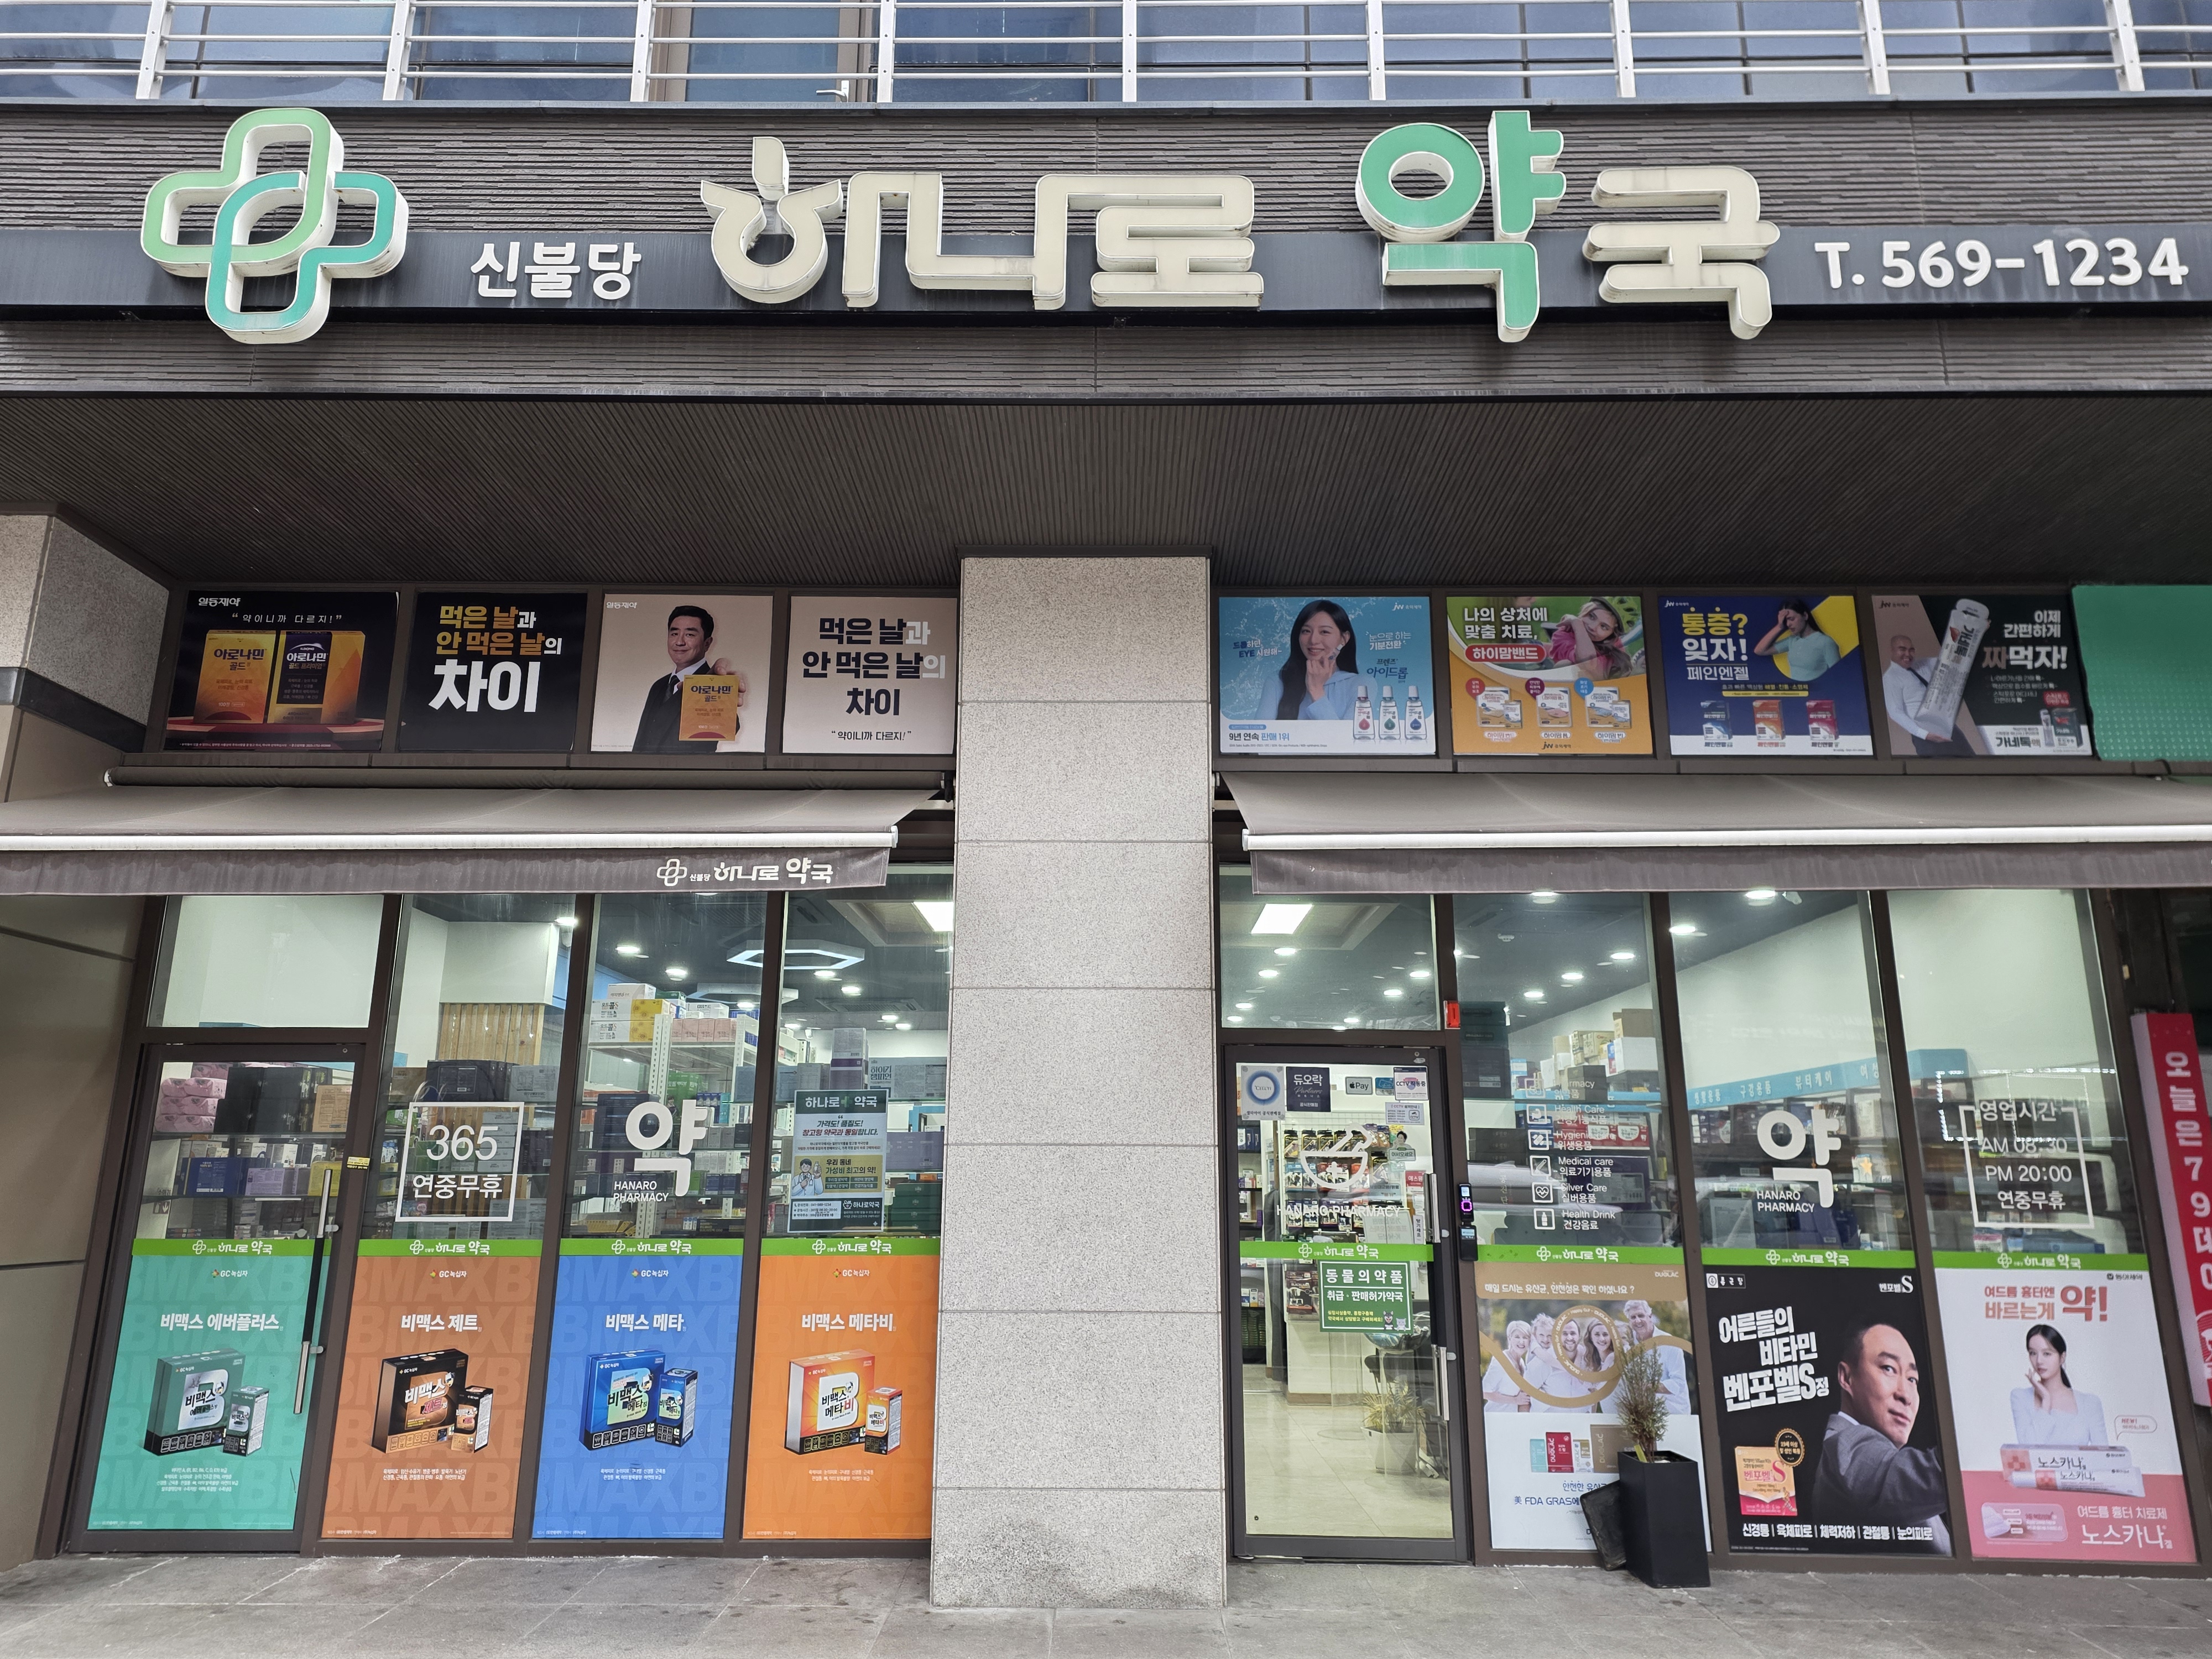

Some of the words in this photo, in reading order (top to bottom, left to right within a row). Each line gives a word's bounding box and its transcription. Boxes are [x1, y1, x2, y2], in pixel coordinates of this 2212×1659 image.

[471, 242, 641, 299] 신불당
[701, 137, 1264, 310] 하나로
[1355, 111, 1780, 342] 약국
[1814, 241, 1865, 289] T.
[1882, 237, 2189, 289] 569-1234
[199, 597, 241, 606] 일동제약
[606, 601, 637, 609] 일동제약
[440, 606, 487, 629] 먹은
[494, 607, 536, 629] 날과
[1464, 607, 1495, 622] 나의
[1500, 607, 1547, 622] 상처에
[1682, 607, 1748, 635] 통증?
[2034, 611, 2060, 623] 이제
[819, 618, 871, 645] 먹은
[879, 618, 931, 645] 날과
[1369, 633, 1393, 642] 눈으로
[1395, 632, 1411, 640] 하는
[1465, 625, 1495, 639] 맞춤
[1502, 624, 1538, 640] 치료,
[2004, 624, 2061, 638] 간편하게
[436, 633, 461, 655] 안
[466, 632, 514, 656] 먹은
[520, 632, 562, 656] 날의
[1370, 641, 1402, 651] 기분전환
[1682, 638, 1748, 661] 잊자!
[214, 649, 264, 660] 아로나민
[286, 653, 326, 662] 아로나민
[1472, 646, 1538, 659] 하이맘밴드
[1982, 646, 2067, 669] 짜먹자!
[229, 662, 246, 670] 골드
[802, 653, 831, 678] 안
[836, 651, 889, 679] 먹은
[895, 652, 946, 680] 날의
[1366, 666, 1408, 679] 아이드롭
[1687, 666, 1749, 680] 페인엔젤
[429, 659, 540, 712] 차이
[691, 685, 731, 694] 아로나민
[846, 688, 899, 716] 차이
[1229, 733, 1241, 741] 9년
[1244, 733, 1259, 741] 연속
[1261, 733, 1276, 741] 판매
[1279, 733, 1290, 741] 1위
[714, 862, 779, 881] 하나로
[786, 858, 833, 884] 약국
[1293, 1074, 1322, 1086] 듀오락
[1356, 1082, 1369, 1091] Pay
[806, 1097, 839, 1108] 하나로
[854, 1096, 877, 1107] 약국
[1980, 1100, 2057, 1121] 영업시간
[426, 1125, 498, 1161] 365
[625, 1099, 707, 1197] 약
[1981, 1138, 2008, 1153] AM
[1558, 1157, 1592, 1166] Medical
[1757, 1109, 1841, 1208] 약
[1559, 1167, 1612, 1177] 의료기기용품
[1986, 1166, 2013, 1181] PM
[2018, 1165, 2072, 1182] 20:00
[413, 1175, 502, 1199] 연중무휴
[614, 1181, 657, 1190] HANARO
[1561, 1183, 1584, 1192] Silver
[1587, 1184, 1608, 1192] Care
[613, 1192, 669, 1202] PHARMACY
[1562, 1194, 1597, 1203] 실버용품
[1757, 1191, 1801, 1200] HANARO
[1997, 1190, 2066, 1210] 연중무휴
[1335, 1206, 1400, 1217] PHARMACY
[1562, 1211, 1590, 1219] Health
[1593, 1211, 1616, 1219] Drink
[1757, 1203, 1814, 1212] PHARMACY
[1563, 1220, 1599, 1230] 건강음료
[1324, 1246, 1354, 1256] 하나로
[1357, 1245, 1379, 1259] 약국
[1563, 1249, 1593, 1259] 하나로
[1595, 1248, 1619, 1262] 약국
[1792, 1253, 1824, 1263] 하나로
[1825, 1251, 1849, 1266] 약국
[2023, 1256, 2055, 1266] 하나로
[2057, 1254, 2081, 1270] 약국
[1485, 1284, 1500, 1293] 매일
[1502, 1285, 1523, 1293] 드시는
[1525, 1285, 1550, 1294] 유산균,
[1551, 1282, 1579, 1294] 안전성은
[1582, 1285, 1597, 1294] 확인
[1985, 1286, 2017, 1298] 여드름
[2021, 1286, 2055, 1298] 흉터엔
[1327, 1291, 1344, 1301] 취급
[1352, 1291, 1403, 1302] 판매허가약국
[2060, 1285, 2108, 1322] 약!
[1985, 1302, 2055, 1321] 바르는게
[160, 1313, 203, 1331] 비맥스
[207, 1313, 279, 1331] 에버플러스
[401, 1314, 445, 1332] 비맥스
[448, 1314, 478, 1332] 제트
[606, 1313, 649, 1332] 비맥스
[653, 1313, 684, 1332] 메타
[802, 1313, 845, 1332] 비맥스
[849, 1313, 893, 1332] 메타비
[1719, 1306, 1794, 1343] 어른들의
[1759, 1332, 1818, 1366] 비타민
[185, 1388, 216, 1408] 비맥스
[405, 1379, 446, 1404] 비맥스
[608, 1385, 643, 1407] 비맥스
[822, 1389, 847, 1406] 비맥스
[825, 1398, 854, 1417] 메타비
[1525, 1497, 1543, 1505] FDA
[1743, 1523, 1770, 1537] 신경통
[1777, 1524, 1813, 1538] 육체피로
[1820, 1525, 1856, 1539] 체력저하
[1863, 1526, 1890, 1540] 관절통
[1897, 1526, 1933, 1541] 눈의피로
[2081, 1524, 2165, 1549] 노스카나
